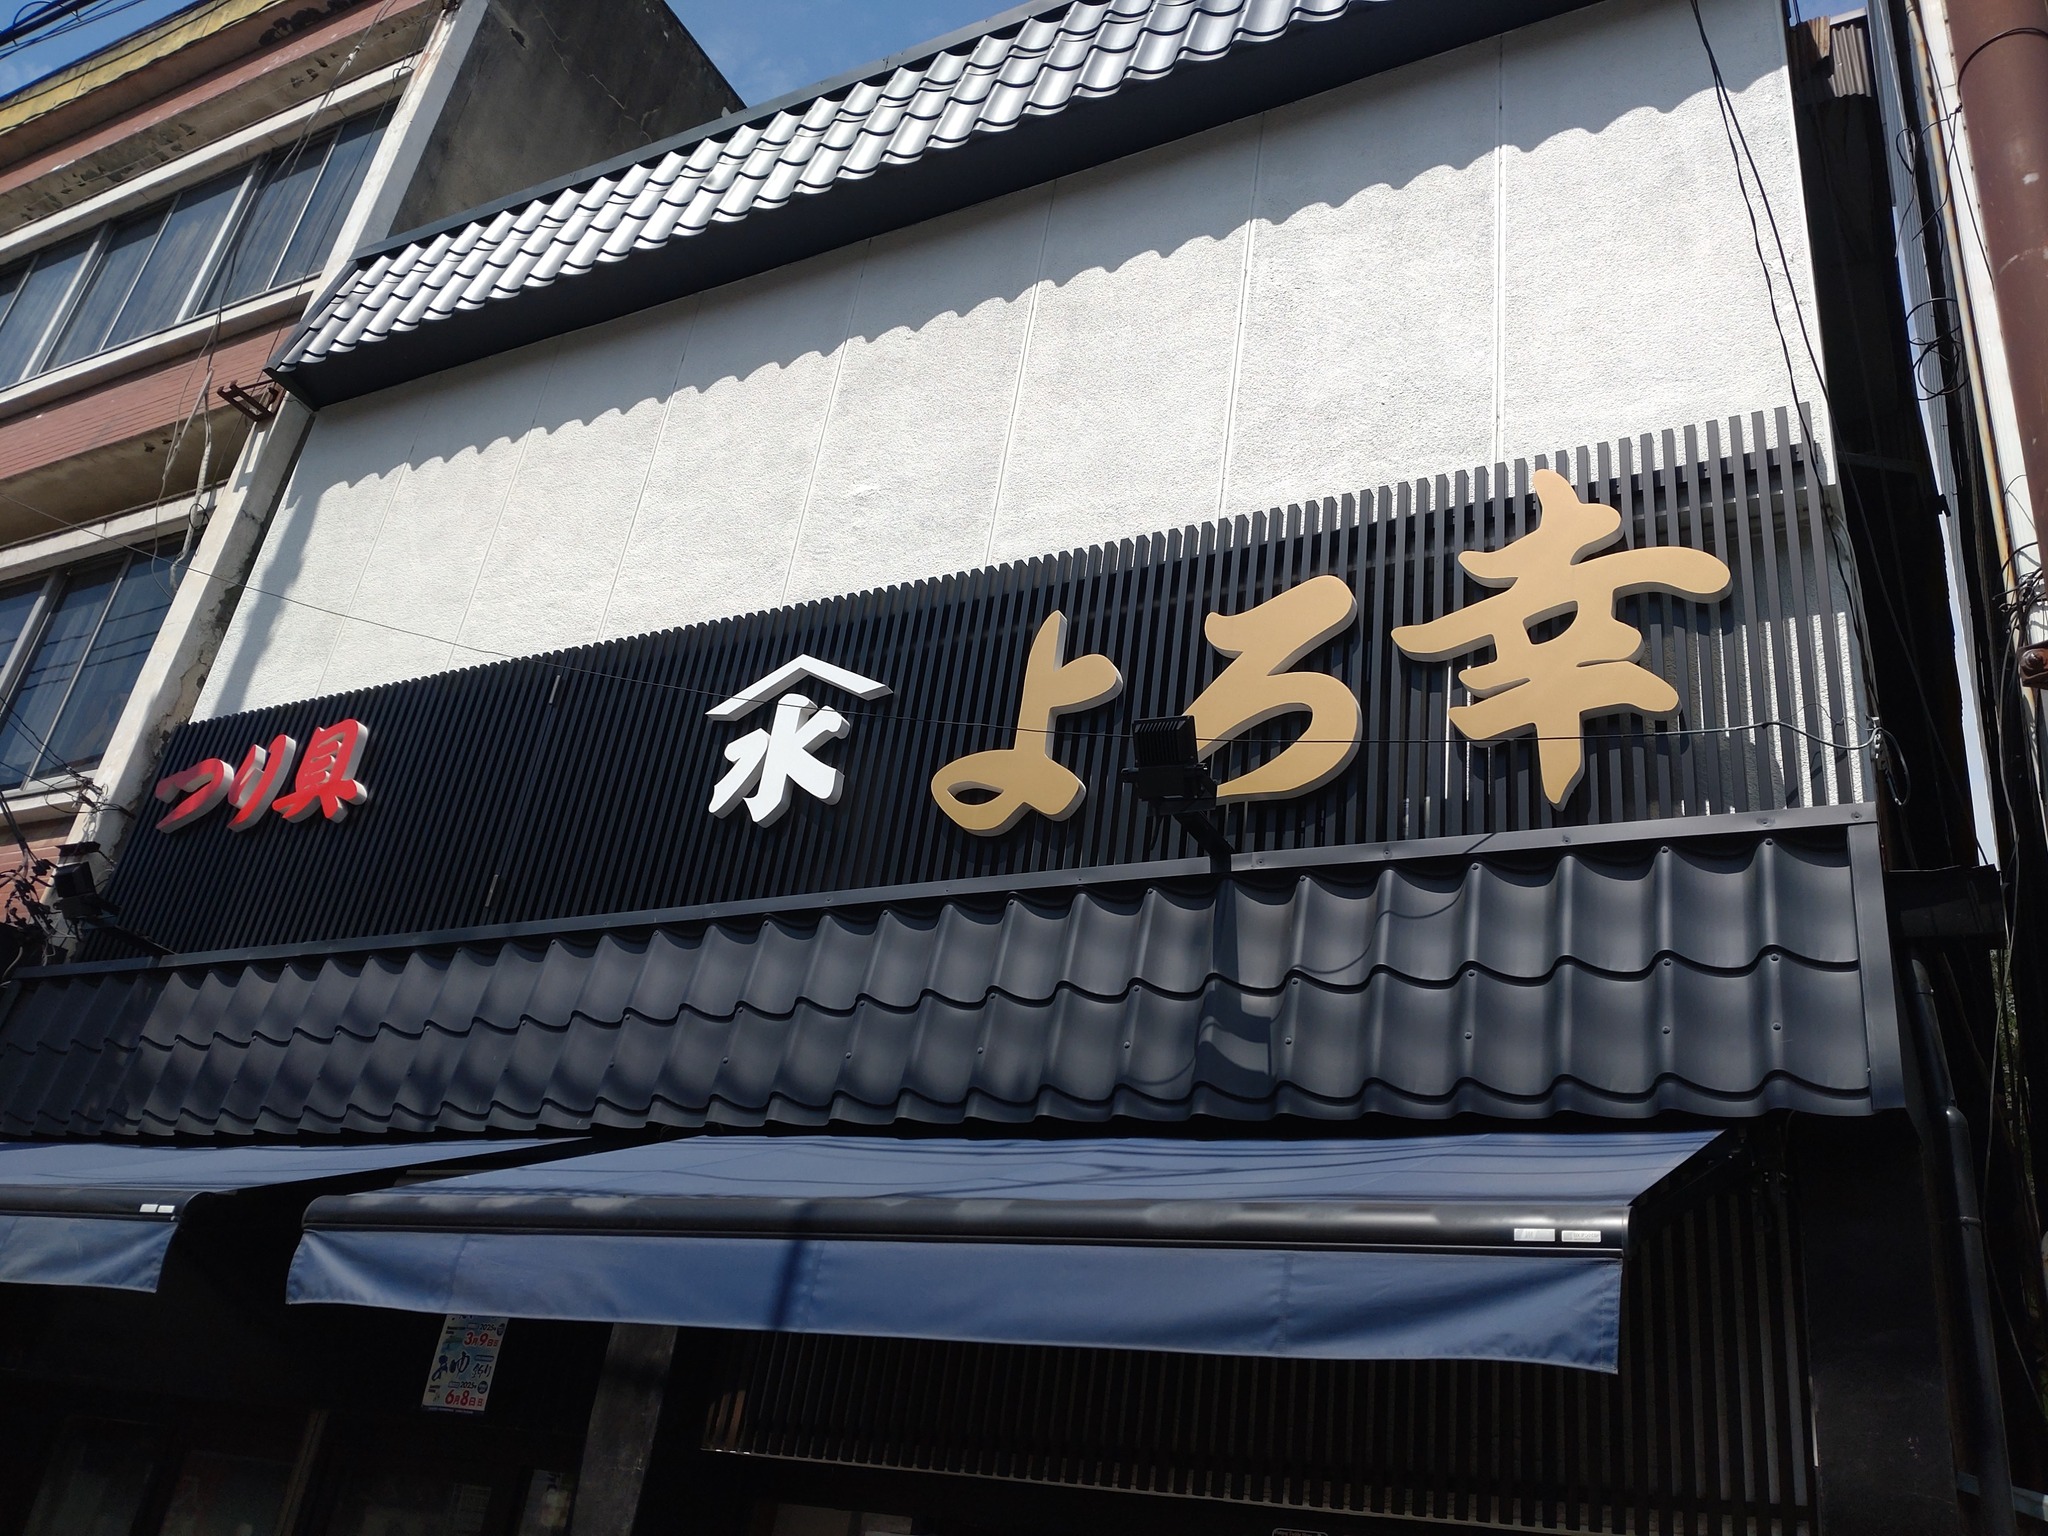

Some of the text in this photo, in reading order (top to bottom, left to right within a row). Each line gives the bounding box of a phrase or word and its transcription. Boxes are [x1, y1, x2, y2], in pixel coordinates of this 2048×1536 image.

[931, 468, 1734, 836] よろ幸
[155, 718, 368, 834] つり具
[708, 692, 851, 828] 水
